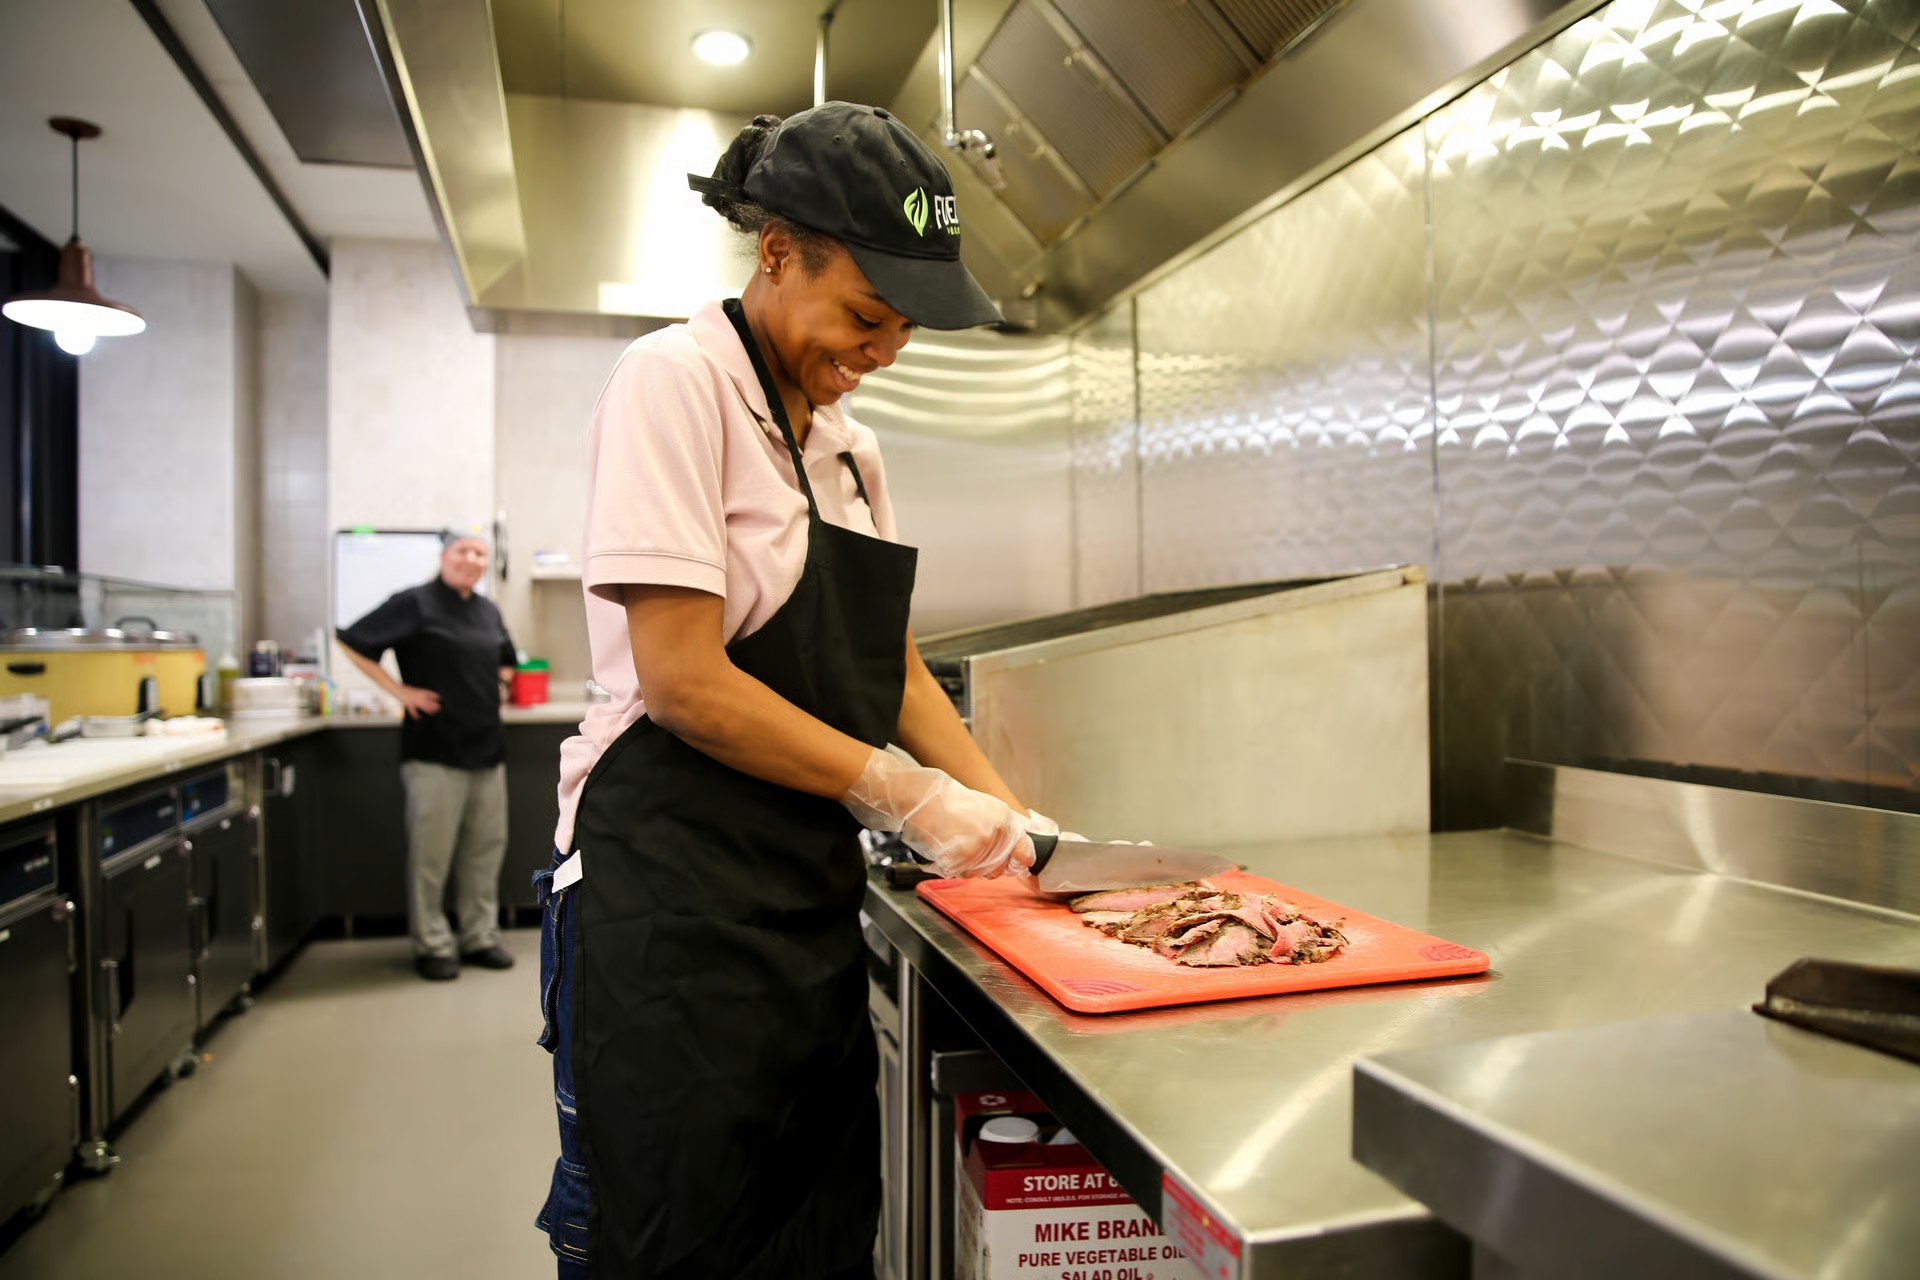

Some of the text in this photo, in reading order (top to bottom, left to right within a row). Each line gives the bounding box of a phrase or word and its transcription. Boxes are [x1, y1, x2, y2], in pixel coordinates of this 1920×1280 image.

[1023, 1174, 1080, 1192] STORE
[1083, 1173, 1106, 1189] AT
[1035, 1222, 1090, 1243] MIKE
[1018, 1245, 1186, 1268] PURE VEGETABLE OIL
[1061, 1268, 1143, 1280] SALAD OIL
